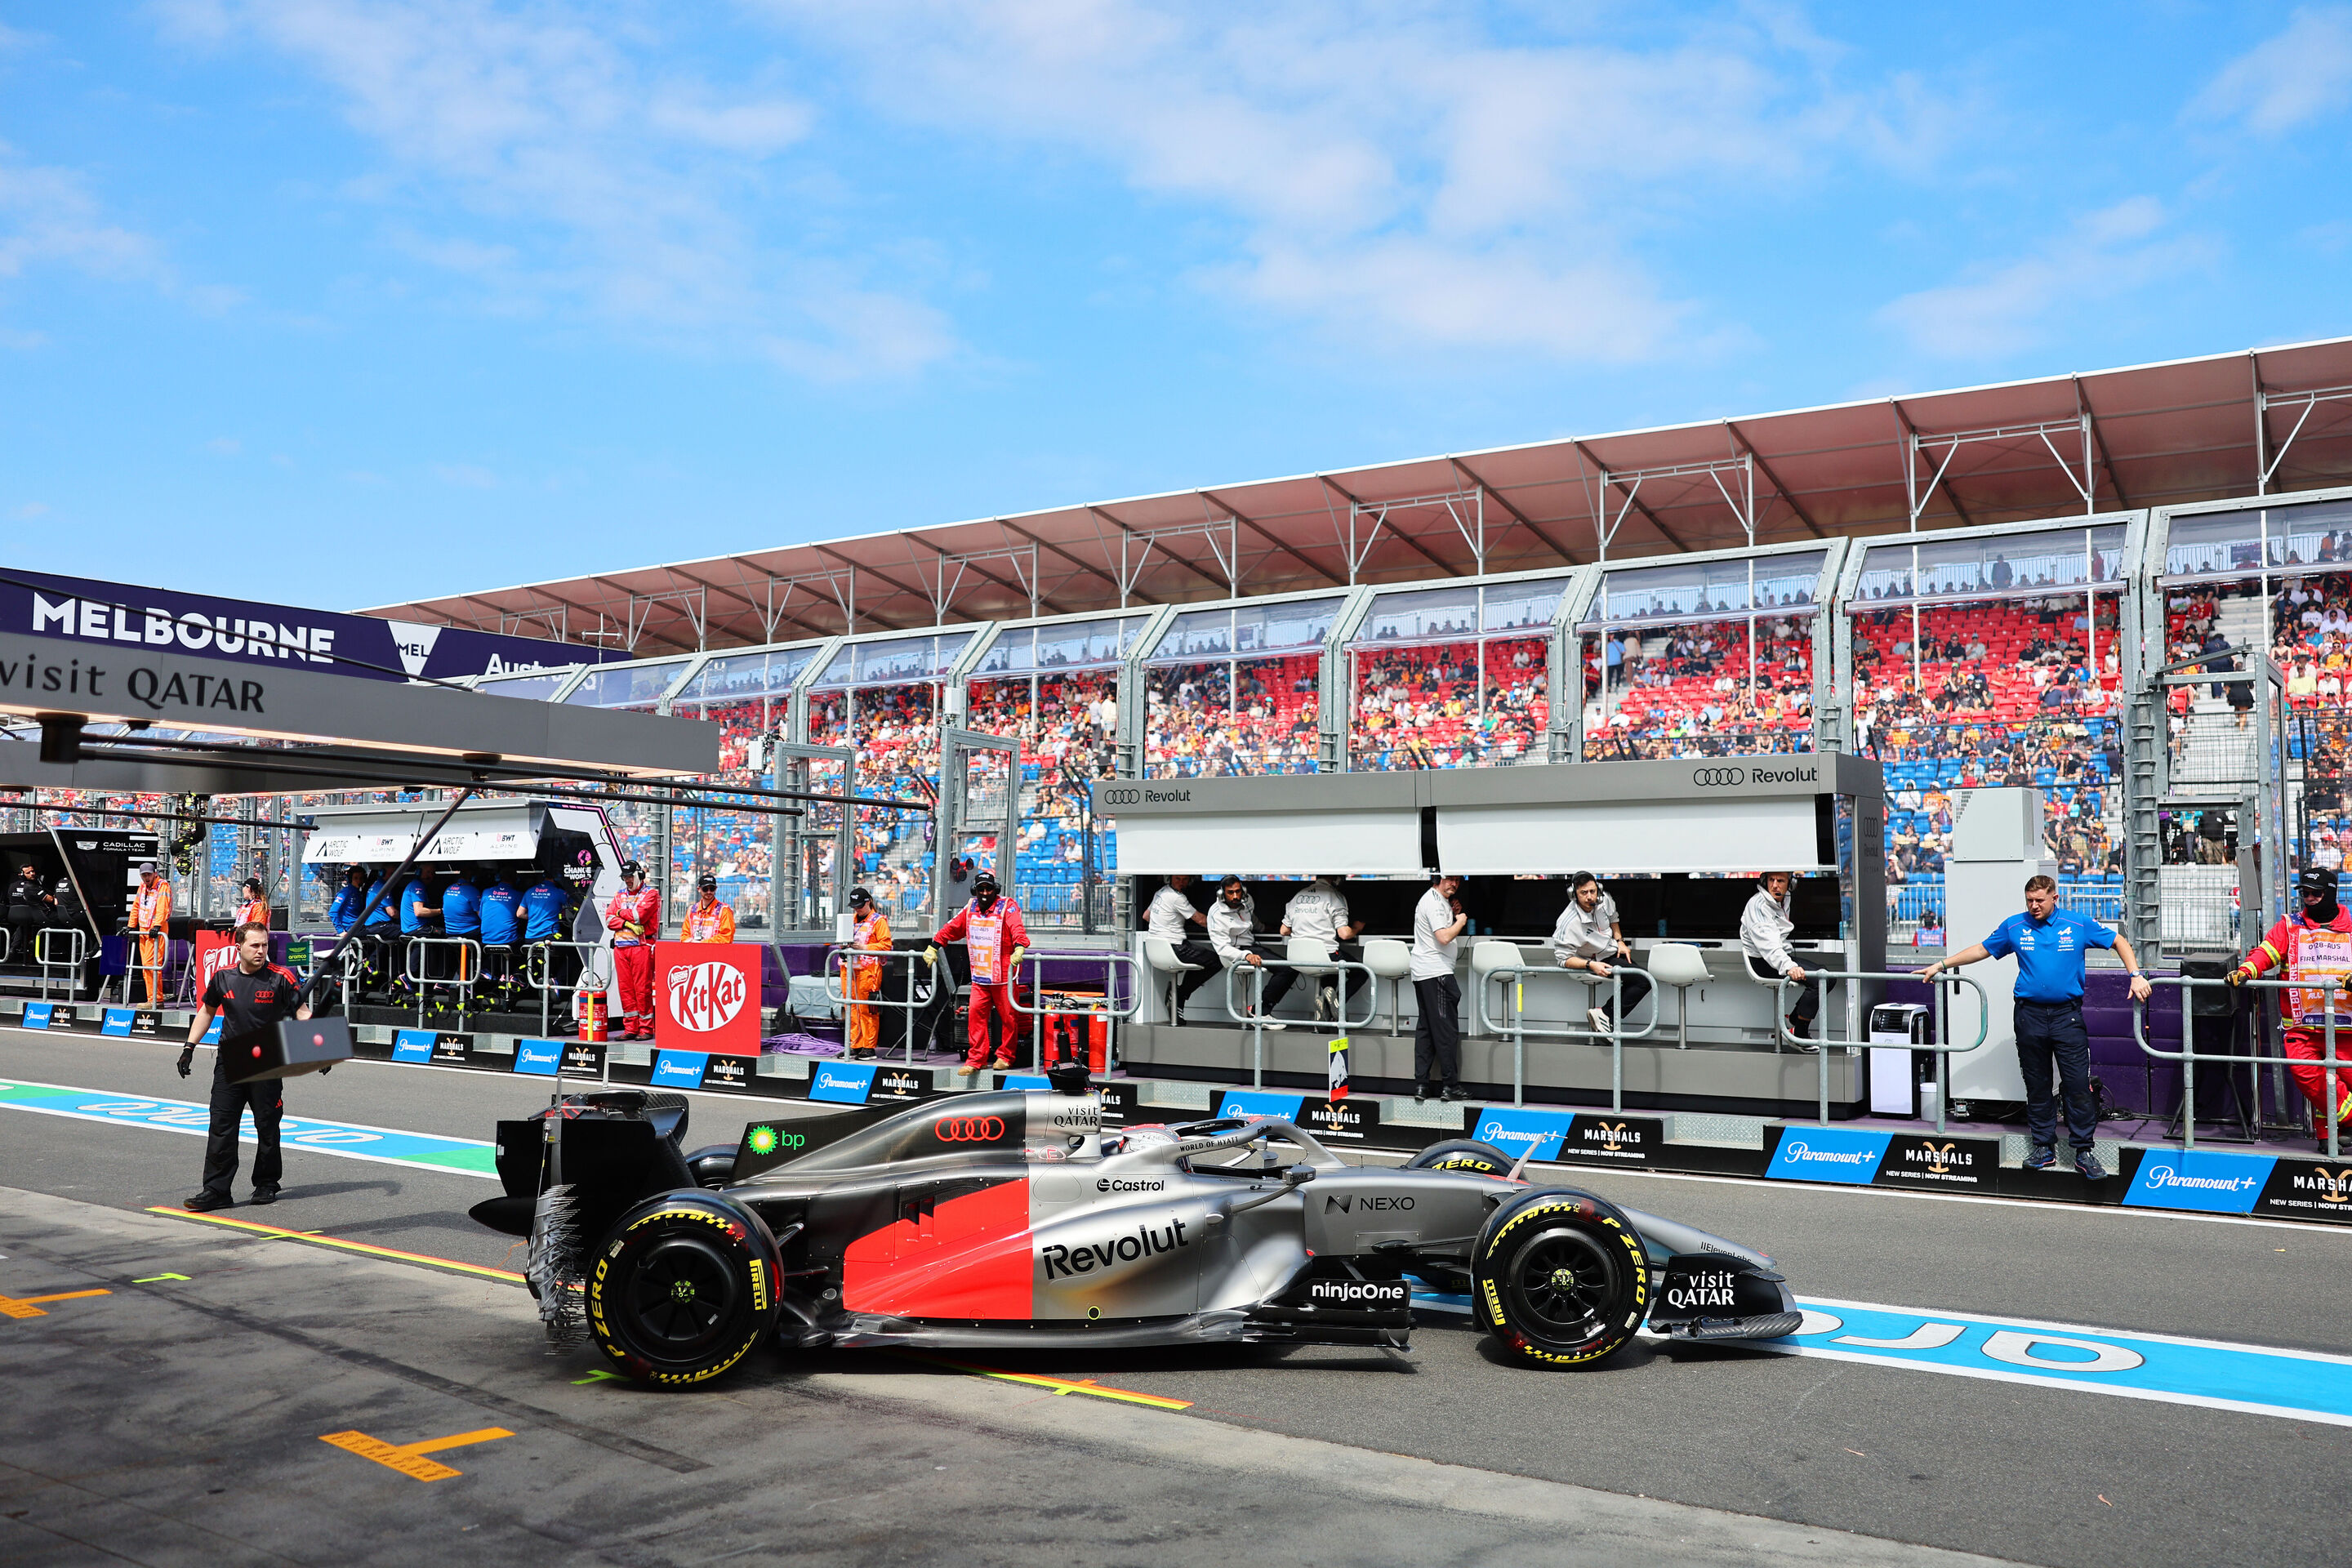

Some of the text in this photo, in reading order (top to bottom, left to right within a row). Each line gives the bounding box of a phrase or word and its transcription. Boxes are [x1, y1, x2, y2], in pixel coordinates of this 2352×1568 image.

[33, 591, 335, 663] MELBOURNE
[398, 642, 429, 657] MEL
[0, 654, 264, 713] visit QATAR
[1752, 767, 1817, 783] Revolut
[1145, 790, 1191, 803] Revolut
[443, 837, 464, 845] ARCTIC
[443, 846, 460, 854] WOLF
[2316, 955, 2350, 963] MARSHAL
[679, 964, 742, 1030] KitKat
[2289, 964, 2302, 1025] MELBORNE
[399, 1038, 430, 1052] Paramount+
[439, 1042, 464, 1051] MARSHALS
[521, 1049, 558, 1063] Paramount+
[568, 1052, 595, 1062] MARSHALS
[661, 1060, 701, 1076] Paramount+
[713, 1064, 744, 1076] MARSHALS
[819, 1072, 867, 1090] Paramount+
[882, 1077, 919, 1089] MARSHALS
[1068, 1105, 1098, 1116] visit
[1312, 1111, 1361, 1124] MARSHALS
[1054, 1116, 1098, 1127] QATAR
[1481, 1121, 1560, 1143] Paramount+
[1584, 1129, 1641, 1143] MARSHALS
[782, 1130, 805, 1151] bp
[1179, 1141, 1204, 1152] WORLD
[1218, 1136, 1239, 1146] HYATT
[1784, 1142, 1875, 1165] Paramount+
[1905, 1149, 1972, 1165] MARSHALS
[1112, 1180, 1164, 1192] Castrol
[1941, 1174, 1977, 1183] STREAMING
[2145, 1165, 2256, 1192] Paramount+
[1361, 1197, 1414, 1210] NEXO
[2270, 1198, 2287, 1206] NEW
[2288, 1200, 2313, 1209] SERIES
[1042, 1218, 1189, 1280] Revolut
[1619, 1233, 1646, 1305] ZERO
[749, 1258, 768, 1311] PIRELLI
[1689, 1270, 1735, 1288] visit
[591, 1258, 611, 1338] ZERO
[1312, 1281, 1404, 1302] ninjaOne
[1668, 1288, 1735, 1309] QATAR
[1482, 1279, 1506, 1326] PIRELLI
